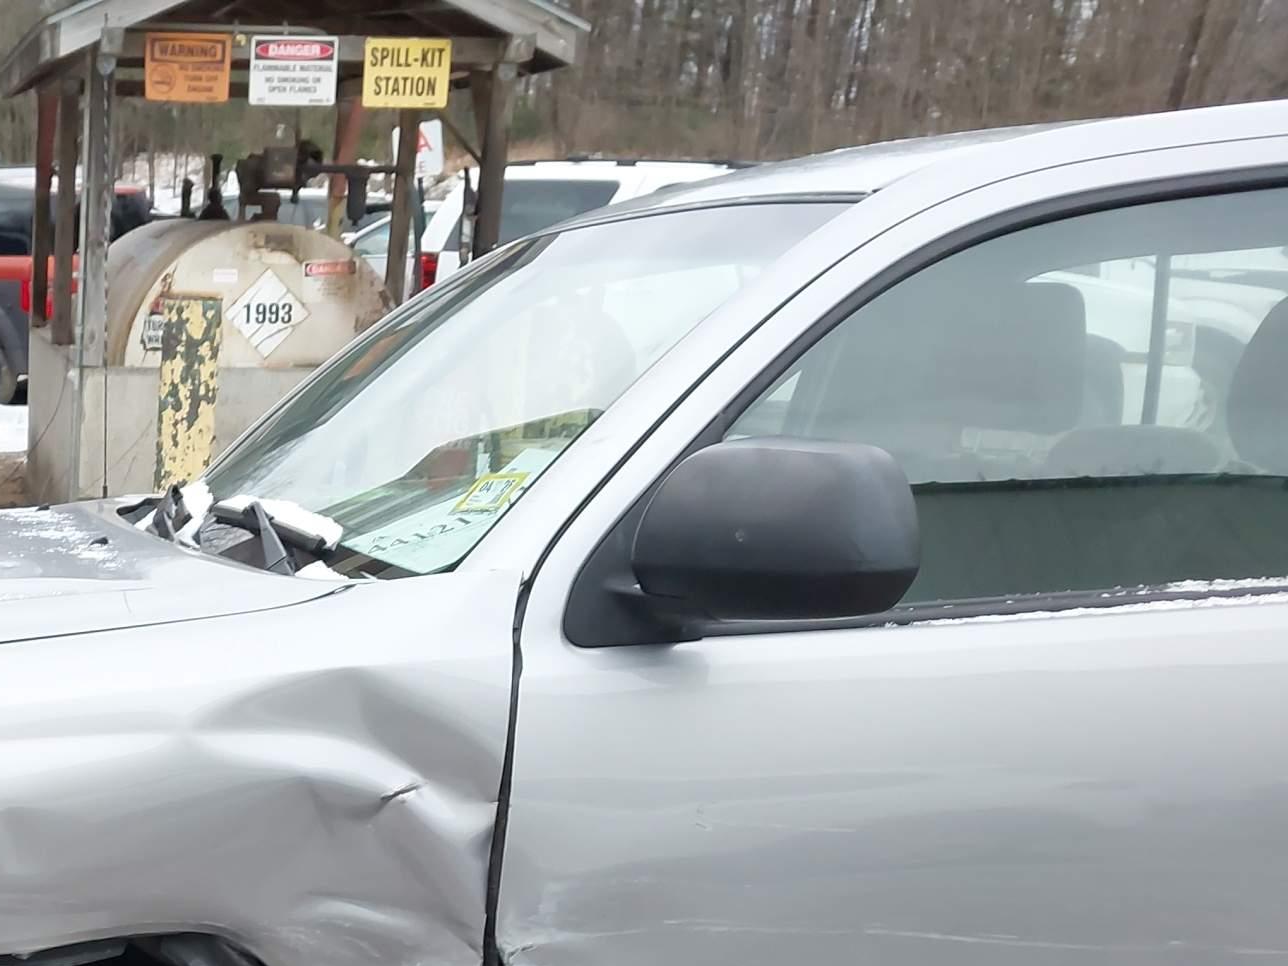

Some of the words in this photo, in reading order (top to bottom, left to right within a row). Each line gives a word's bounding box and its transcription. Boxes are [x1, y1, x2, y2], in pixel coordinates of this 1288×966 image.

[159, 44, 217, 57] WARNING
[268, 44, 321, 56] DANGER
[370, 47, 446, 67] SPILL-KIT
[277, 76, 310, 84] SMOKING
[373, 76, 437, 96] STATION
[243, 302, 293, 324] 1993
